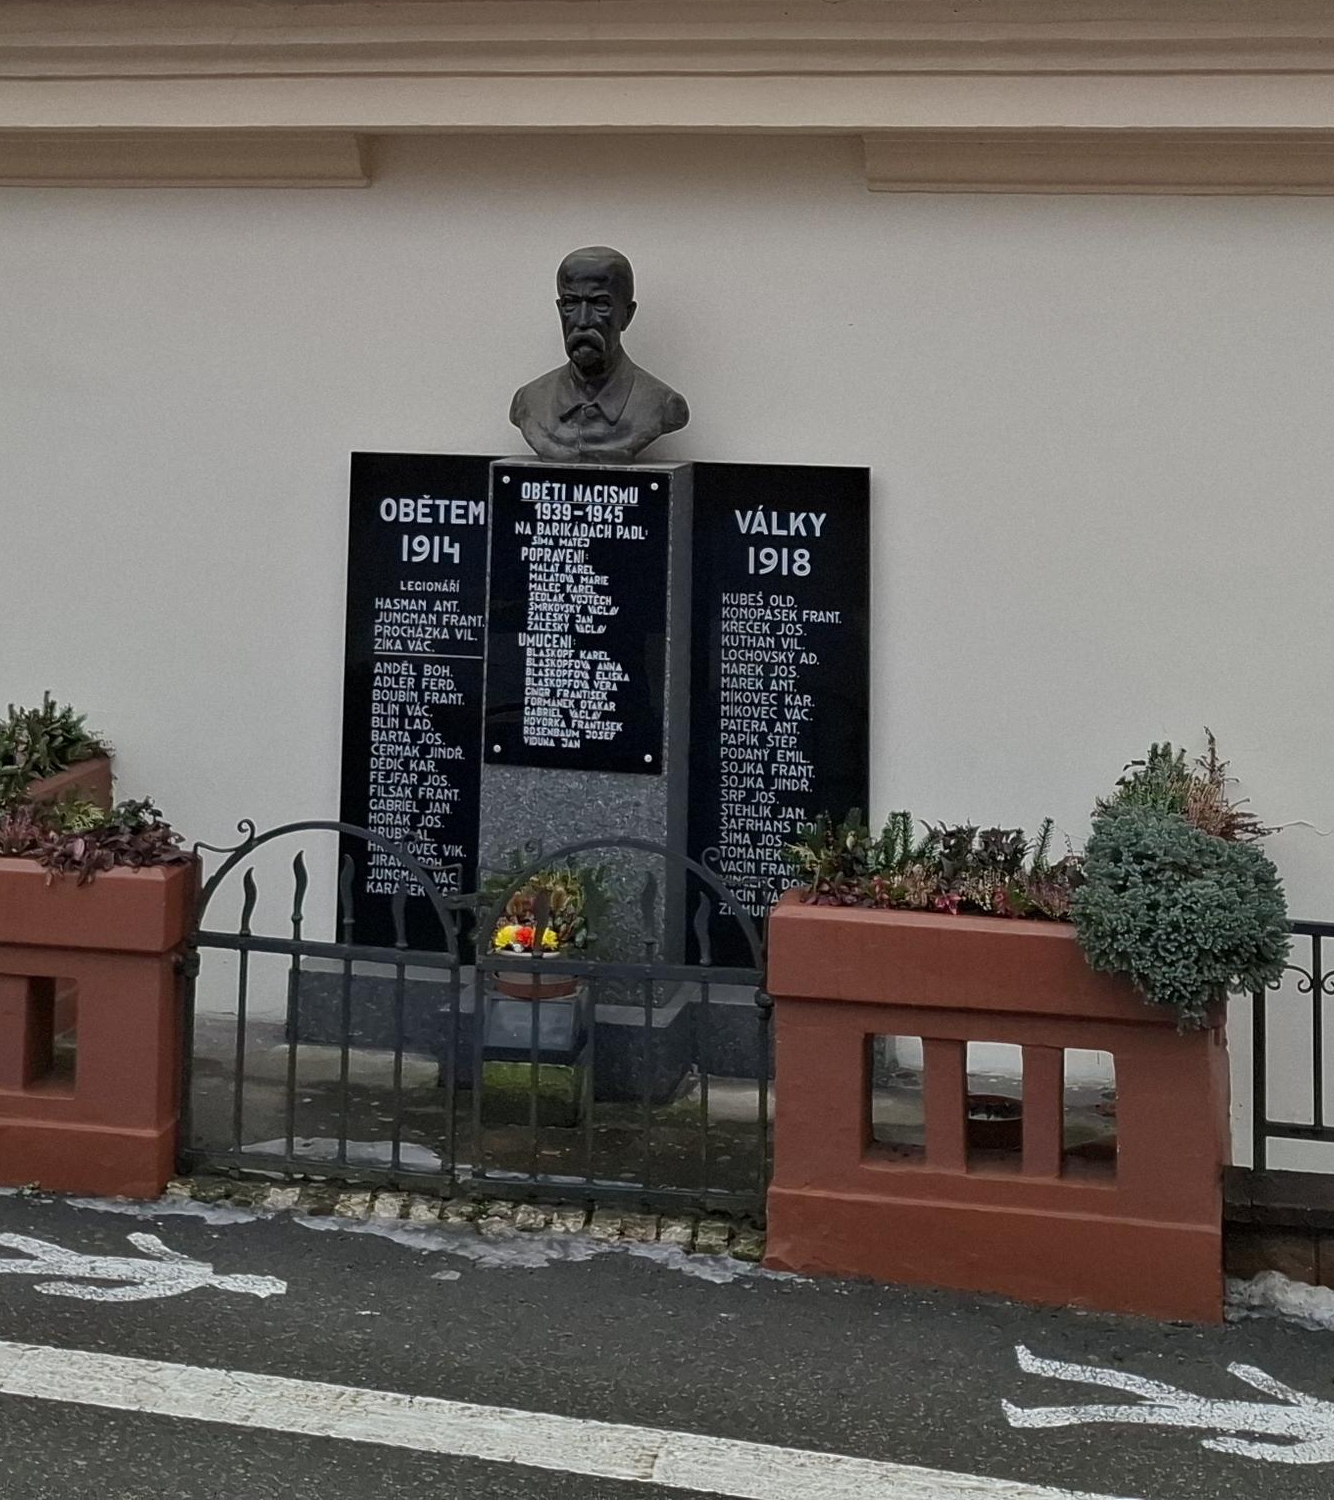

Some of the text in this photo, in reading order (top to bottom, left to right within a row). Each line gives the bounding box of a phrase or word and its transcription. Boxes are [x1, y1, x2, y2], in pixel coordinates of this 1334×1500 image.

[573, 484, 638, 503] NACISMU
[380, 495, 485, 525] OBĚTEM
[735, 505, 826, 536] VÁLKY
[515, 521, 532, 535] NA
[402, 535, 460, 563] 1914
[749, 547, 811, 576] 1918
[565, 565, 595, 575] KAREL
[580, 575, 609, 585] MARIE
[567, 584, 597, 595] KAREL
[375, 598, 460, 612] HASMAN ANT.
[769, 595, 798, 608] OLD.
[374, 611, 485, 627] JUNGMAN FRANT.
[575, 615, 593, 623] JAN
[803, 610, 842, 623] FRANT.
[374, 625, 477, 641] PROCHÁZKA VIL.
[776, 624, 807, 636] JOS.
[408, 639, 435, 652] VÁC.
[721, 635, 806, 650] KUTHAN VIL.
[580, 650, 611, 660] KAREL
[800, 653, 820, 665] AD.
[423, 665, 453, 677] BOH.
[721, 662, 800, 678] MAREK JOS.
[374, 676, 456, 691] ADLER FERD.
[721, 677, 797, 692] MAREK ANT.
[425, 692, 465, 705] FRANT.
[785, 694, 815, 707] KAR.
[580, 701, 616, 711] OTAKAR
[405, 718, 434, 731] LAD.
[524, 717, 566, 727] HOVORKA
[721, 719, 800, 734] PATERA ANT.
[417, 732, 445, 745] JOS.
[585, 730, 616, 740] JOSEF
[561, 738, 580, 748] JAN
[410, 760, 438, 772] KAR.
[721, 761, 815, 778] SOJKA FRANT.
[369, 771, 450, 786] FEJFAR JOS.
[720, 775, 764, 789] SOJKA
[418, 788, 461, 801] FRANT.
[720, 790, 779, 804] SRP JOS.
[425, 802, 453, 814] JAN.
[778, 807, 807, 820] JAN.
[417, 815, 445, 828] JOS.
[443, 844, 466, 857] VIK.
